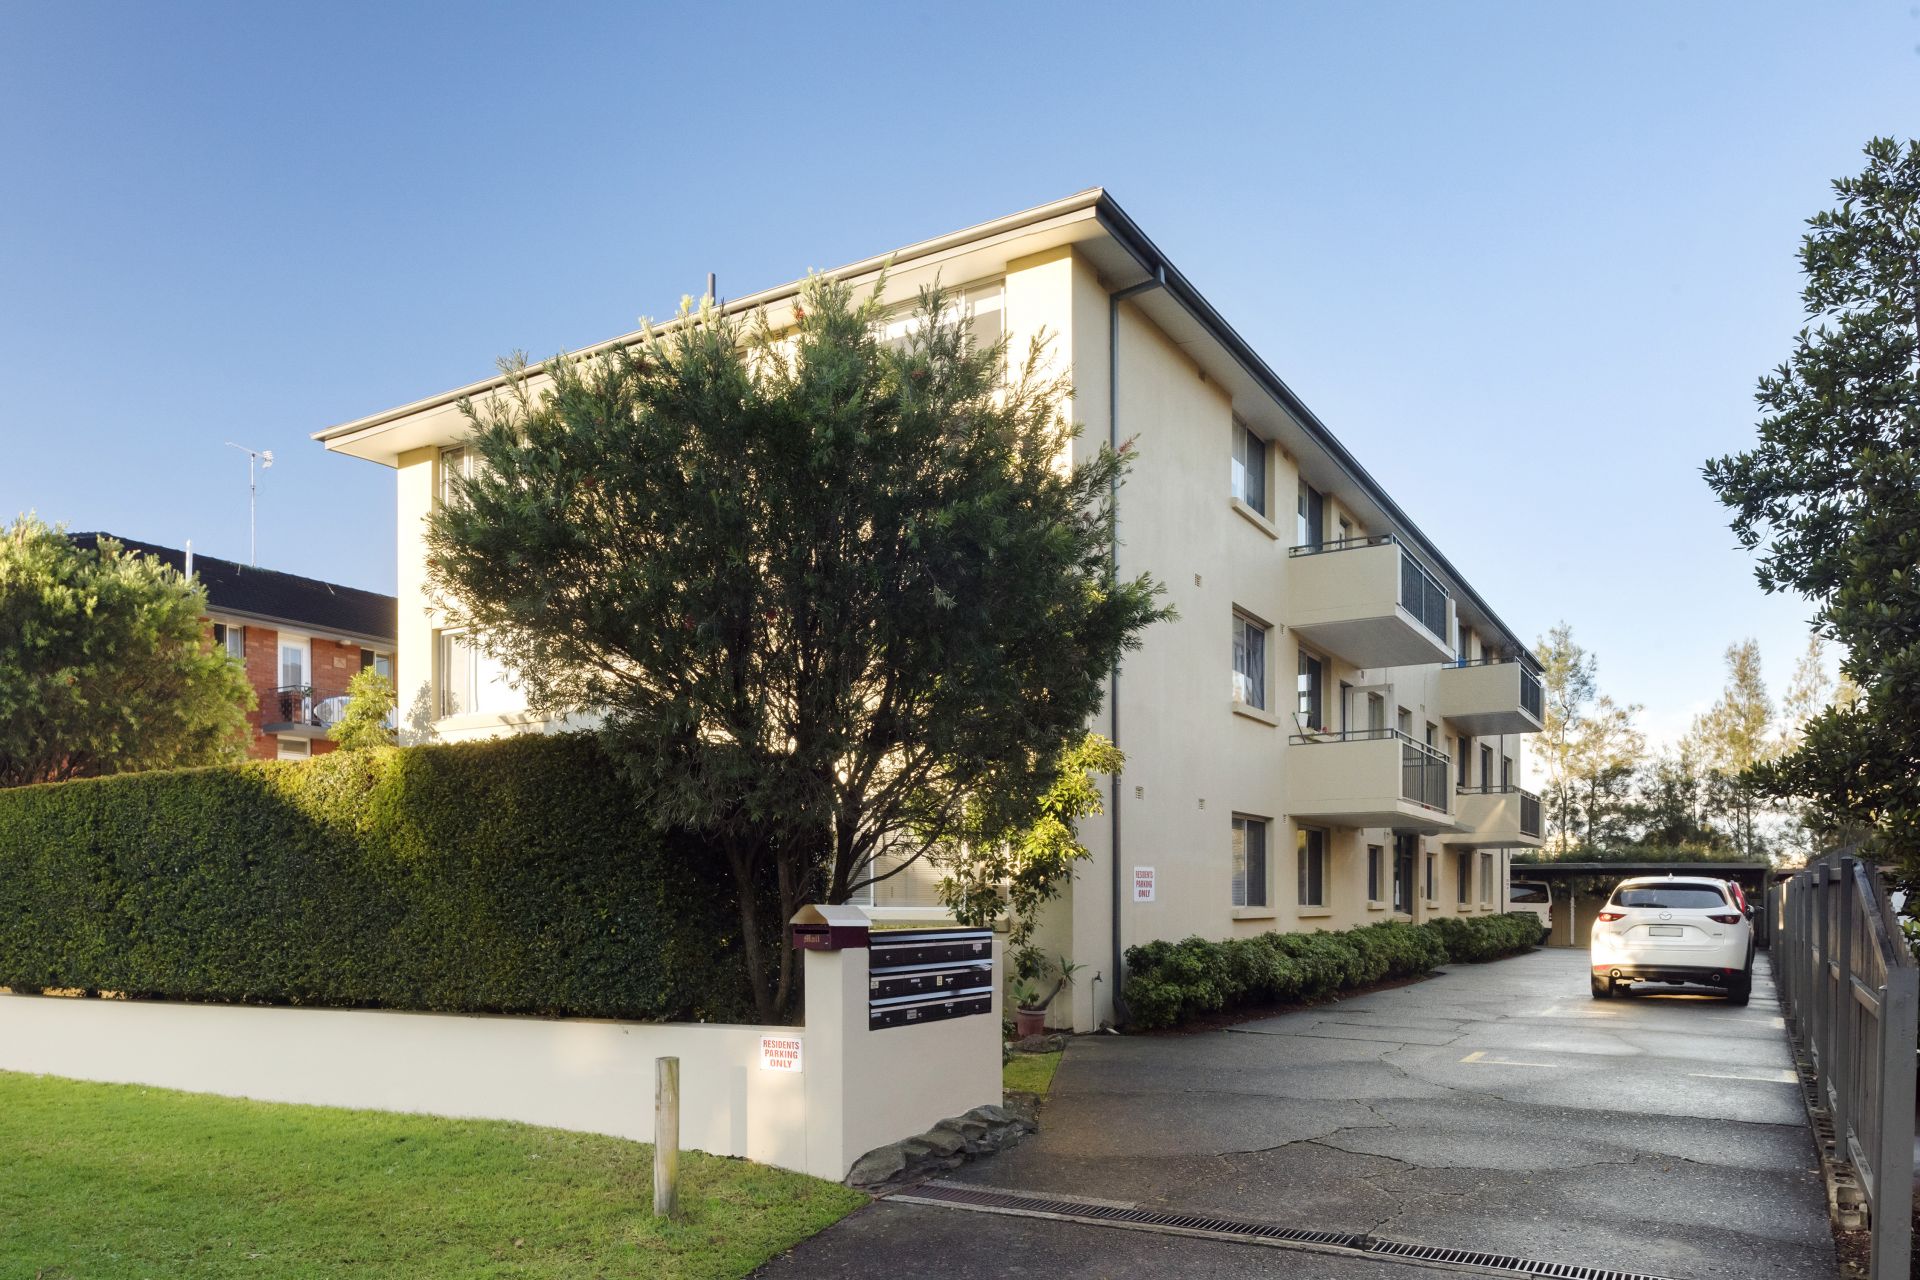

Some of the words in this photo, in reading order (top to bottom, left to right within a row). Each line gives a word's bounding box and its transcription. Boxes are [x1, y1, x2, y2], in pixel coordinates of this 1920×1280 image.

[1139, 889, 1150, 897] ONLY
[804, 934, 820, 943] Mail
[763, 1040, 799, 1051] RESIDENTS
[765, 1049, 798, 1060] PARKING
[770, 1059, 792, 1068] ONLY
